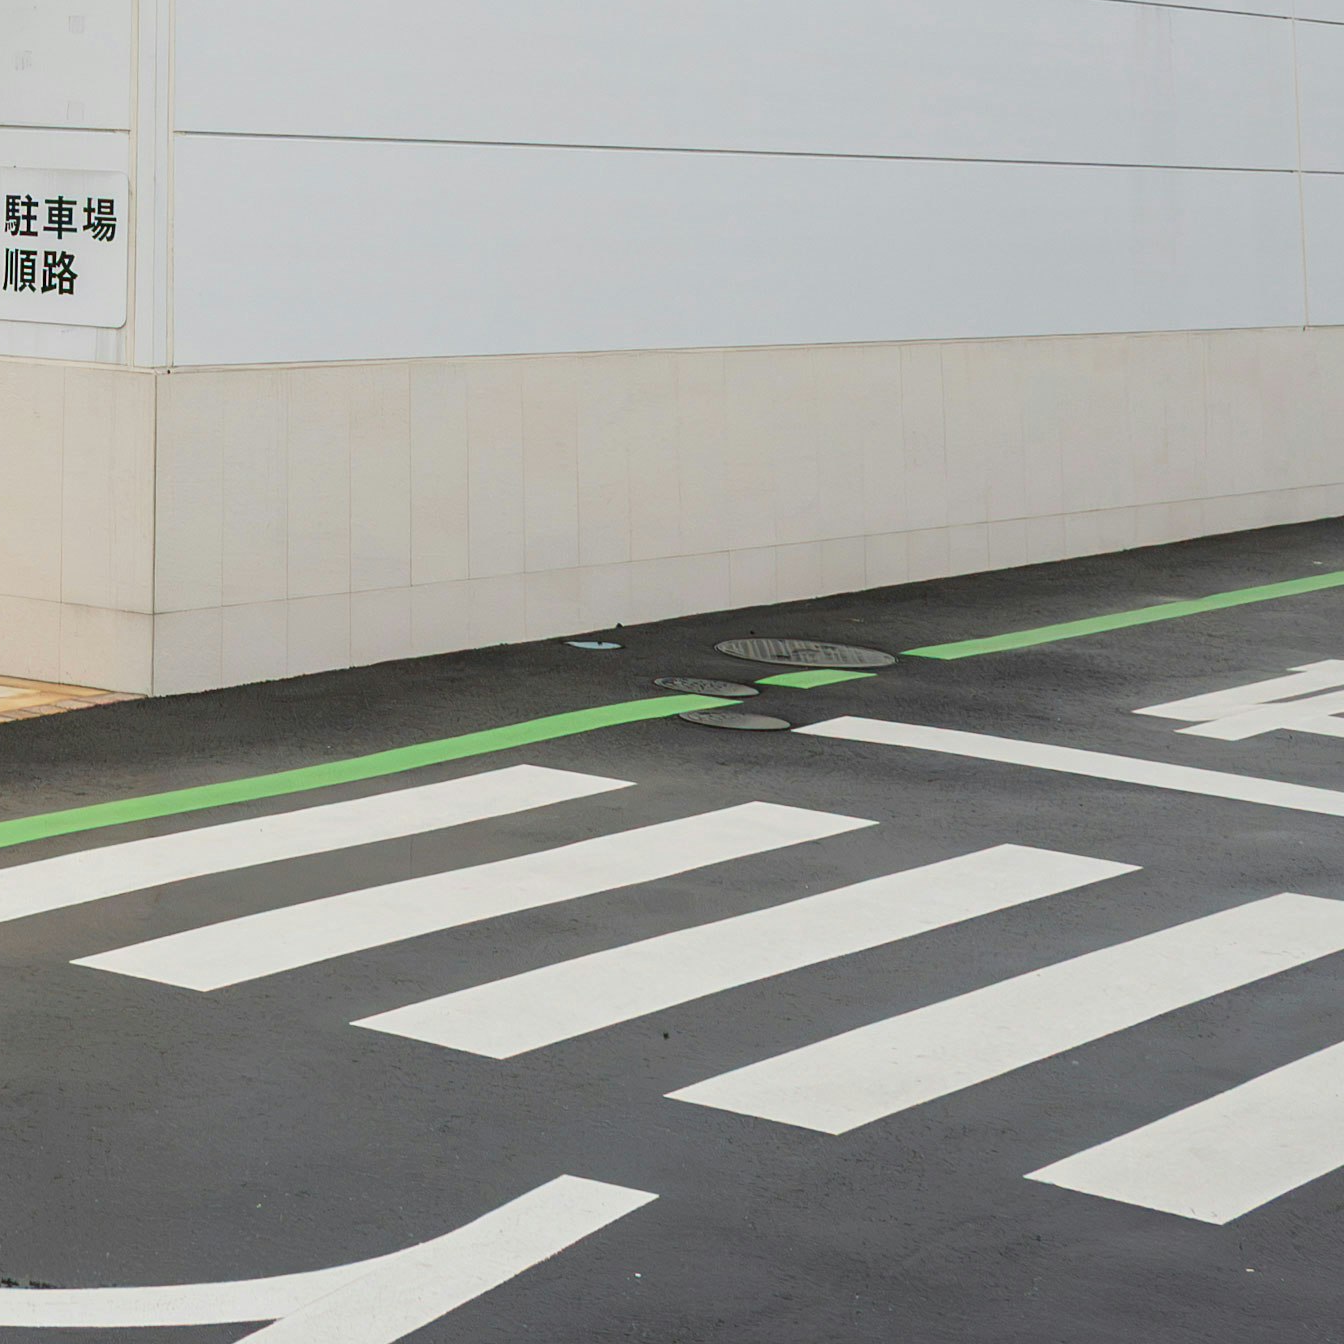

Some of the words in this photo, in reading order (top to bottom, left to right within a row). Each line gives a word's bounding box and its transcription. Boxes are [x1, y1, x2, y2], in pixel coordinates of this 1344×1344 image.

[4, 194, 117, 242] 駐車場
[2, 248, 78, 295] 順路
